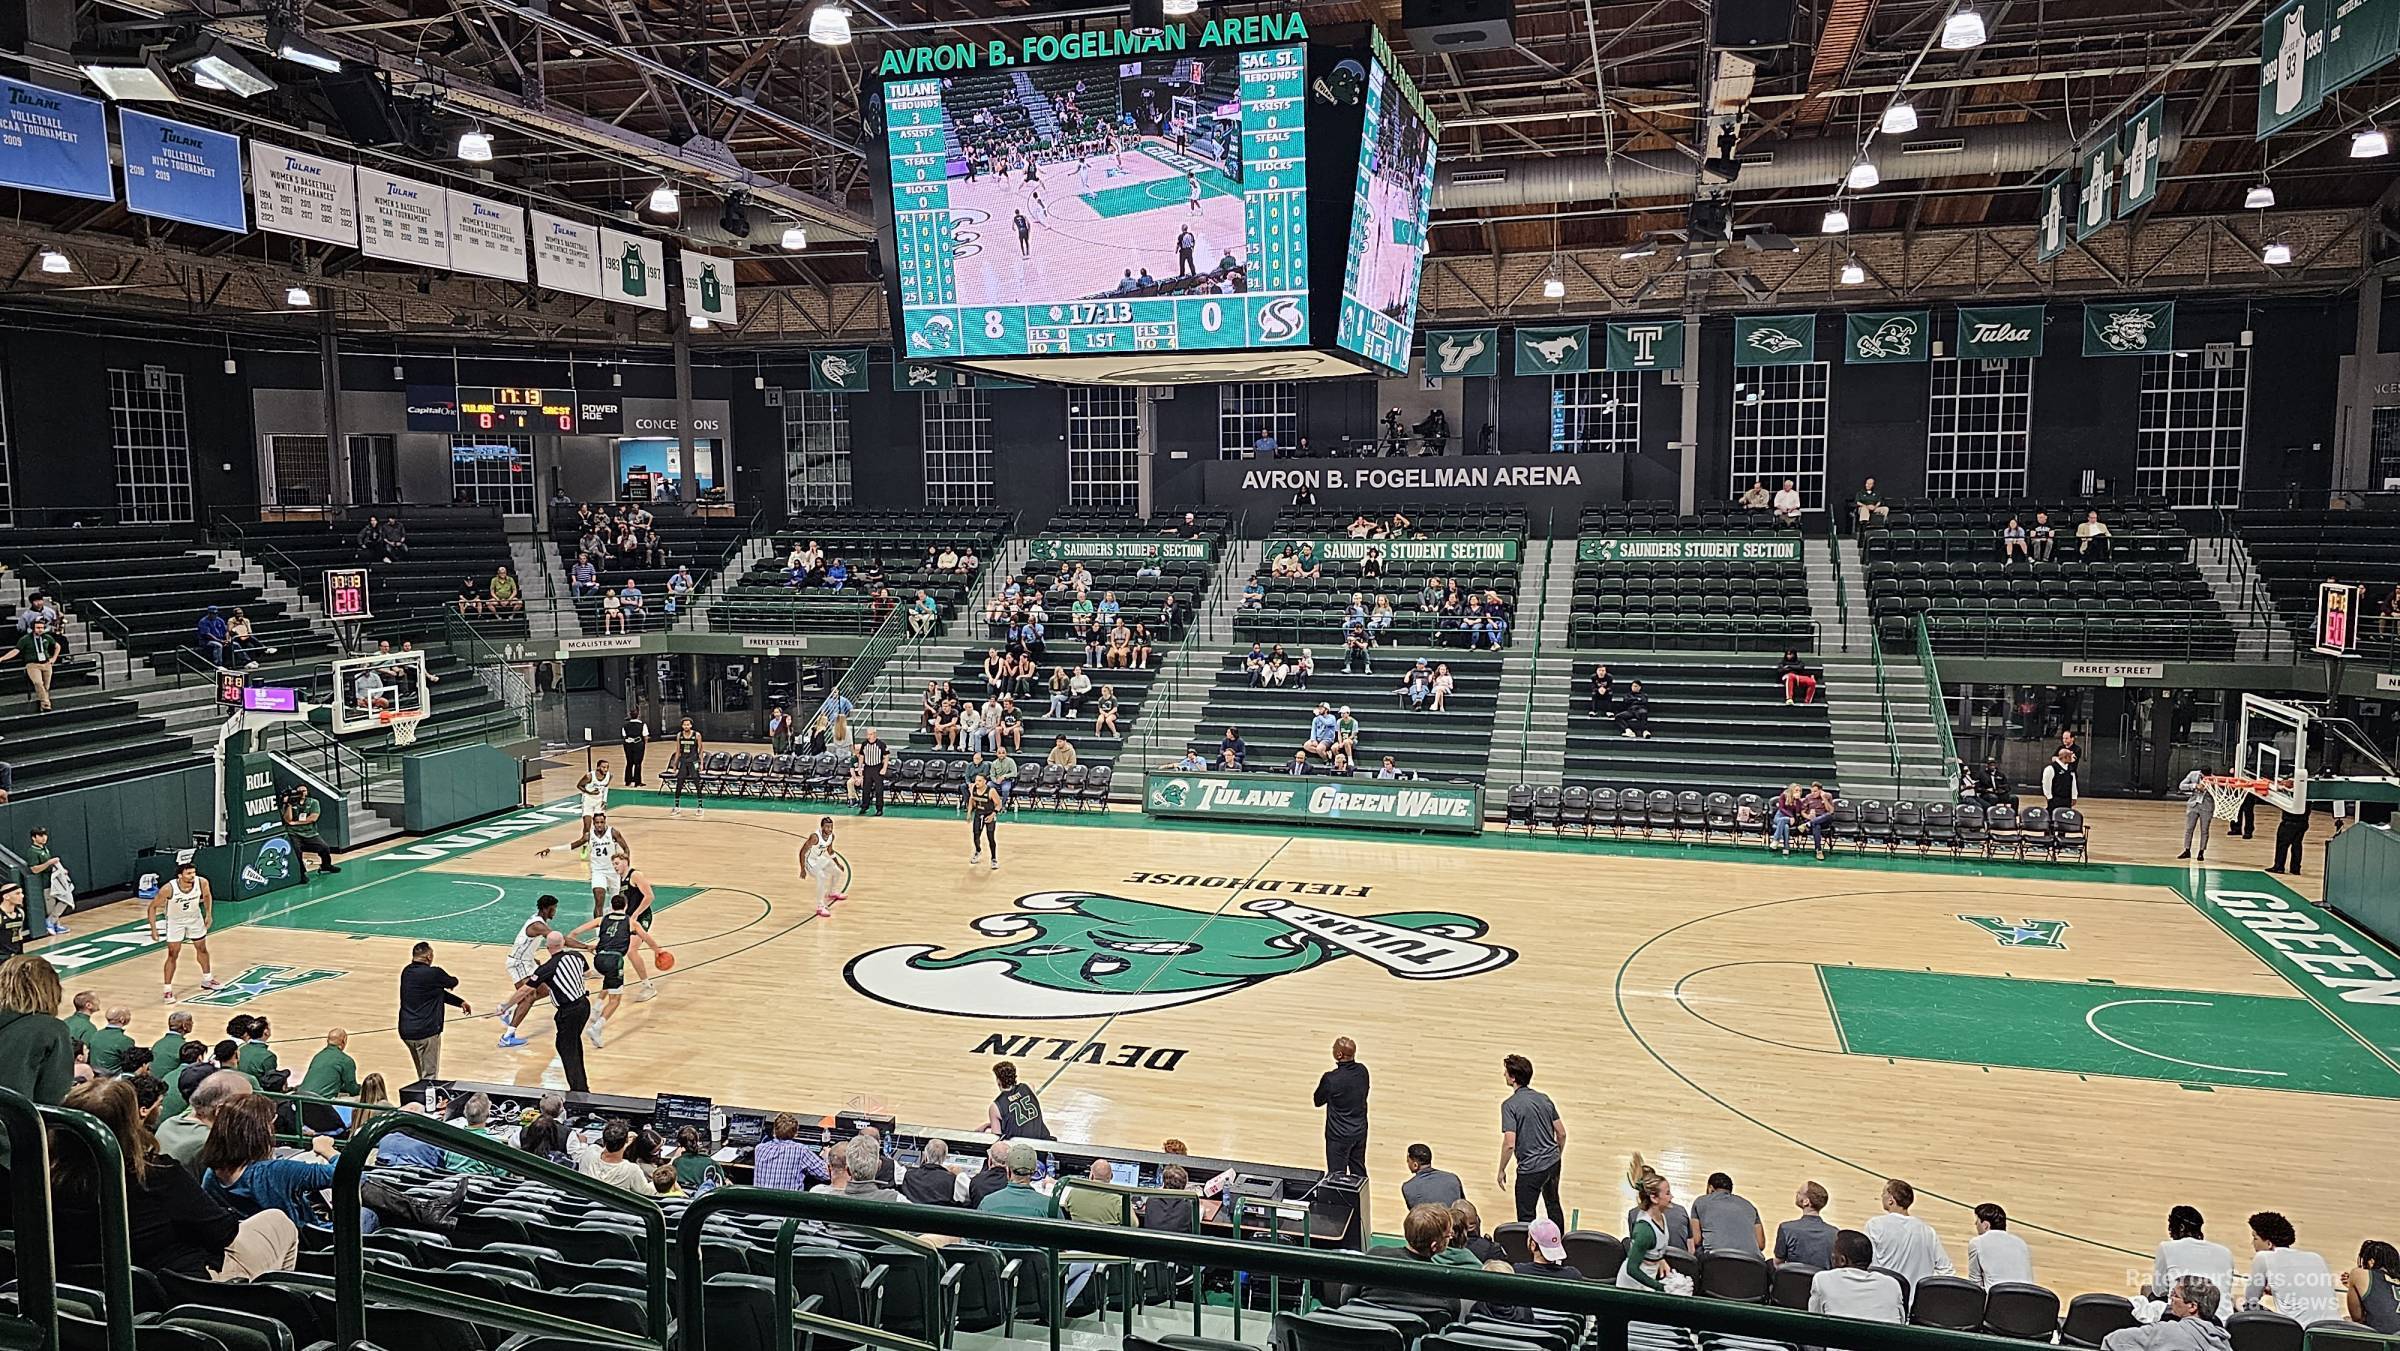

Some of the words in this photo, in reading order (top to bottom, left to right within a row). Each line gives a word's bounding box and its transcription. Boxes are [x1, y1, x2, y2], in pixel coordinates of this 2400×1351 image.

[879, 42, 976, 76] AVRON
[989, 41, 1015, 67] B.
[1023, 23, 1186, 63] FOGELMAN
[1199, 12, 1309, 48] ARENA
[1242, 54, 1272, 69] SAC.
[1276, 51, 1297, 65] ST.
[2286, 52, 2297, 81] 93
[1245, 70, 1298, 83] REBOUNDS
[889, 82, 937, 98] TULANE
[1266, 85, 1276, 98] 3
[8, 86, 61, 110] TULANE
[892, 100, 938, 110] REBOUNDS
[1252, 101, 1290, 112] ASSISTS
[10, 109, 63, 129] VOLLEYBALL
[912, 112, 920, 124] 3
[1268, 116, 1277, 128] 0
[23, 123, 78, 144] TOURNAMENT
[160, 127, 204, 149] TULANE
[901, 128, 934, 139] ASSISTS
[1256, 132, 1290, 142] STEALS
[914, 141, 922, 152] 1
[1269, 146, 1277, 159] 0
[162, 147, 205, 166] VOLLEYBALL
[904, 157, 935, 166] STEALS
[171, 160, 215, 178] TOURNAMENT
[285, 156, 322, 176] TULANE
[1255, 162, 1293, 172] BLOCKS
[917, 169, 926, 181] 0
[1269, 176, 1278, 188] 0
[300, 175, 336, 193] BASKETBALL
[387, 182, 418, 199] TULANE
[906, 185, 938, 194] BLOCKS
[293, 185, 334, 201] APPEARANCES
[400, 202, 431, 216] BASKETBALL
[919, 196, 928, 208] 0
[395, 209, 428, 224] TOURNAMENT
[473, 202, 500, 219] TULANE
[939, 213, 946, 221] F
[1248, 209, 1255, 219] 1
[1293, 206, 1300, 216] 0
[553, 222, 577, 238] TULANE
[902, 228, 908, 238] 1
[941, 226, 948, 235] 0
[1248, 226, 1256, 237] 4
[1293, 223, 1301, 234] 0
[1246, 243, 1259, 254] 15
[605, 257, 620, 271] 1983
[1295, 258, 1302, 269] 0
[630, 265, 639, 280] 10
[647, 266, 661, 280] 1987
[903, 277, 915, 286] 24
[1295, 275, 1302, 286] 0
[708, 284, 714, 298] 4
[1070, 303, 1132, 325] 17:13
[1202, 302, 1222, 332] 0
[984, 311, 1005, 339] 8
[1137, 325, 1159, 337] FLS
[1167, 324, 1175, 336] 1
[1029, 329, 1050, 340] FLS
[1058, 328, 1066, 339] 0
[1086, 333, 1116, 348] 1ST
[1969, 323, 2032, 344] Tulsa
[1031, 343, 1048, 353] TO
[1058, 342, 1067, 353] 4
[1140, 339, 1156, 349] TO
[1168, 338, 1176, 349] 4
[2212, 351, 2226, 366] N
[501, 389, 540, 405] 17:13
[461, 404, 495, 414] TULANE
[581, 404, 618, 414] POWER
[480, 413, 492, 429] 8
[518, 416, 524, 427] 1
[559, 415, 571, 431] 0
[1242, 470, 1321, 490] AVRON
[1327, 470, 1349, 489] B.
[1355, 467, 1488, 488] FOGELMAN
[1493, 465, 1582, 487] ARENA
[1064, 543, 1114, 557] SAUNDERS
[1163, 544, 1204, 558] SECTION
[1391, 543, 1447, 559] STUDENT
[1451, 543, 1505, 559] SECTION
[1620, 542, 1682, 558] SAUNDERS
[1684, 543, 1740, 558] STUDENT
[1743, 543, 1795, 558] SECTION
[332, 575, 361, 589] 17:13
[336, 588, 360, 612] 20
[568, 641, 613, 649] MCALISTER
[2073, 665, 2110, 674] FRERET
[2114, 666, 2152, 675] STREET
[224, 686, 240, 700] 20
[245, 771, 273, 791] ROLL
[1196, 780, 1294, 811] TULANE
[1308, 785, 1396, 815] GREEN
[1395, 790, 1470, 817] WAVE
[245, 795, 279, 817] WAVE
[595, 848, 608, 857] 24
[1122, 871, 1374, 898] FIELDHOUSE
[182, 902, 190, 911] 5
[605, 921, 618, 938] 4
[1293, 913, 1456, 966] TULANE
[2205, 890, 2400, 1006] GREEN
[969, 1032, 1190, 1072] DEVLIN
[1008, 1095, 1039, 1127] 25
